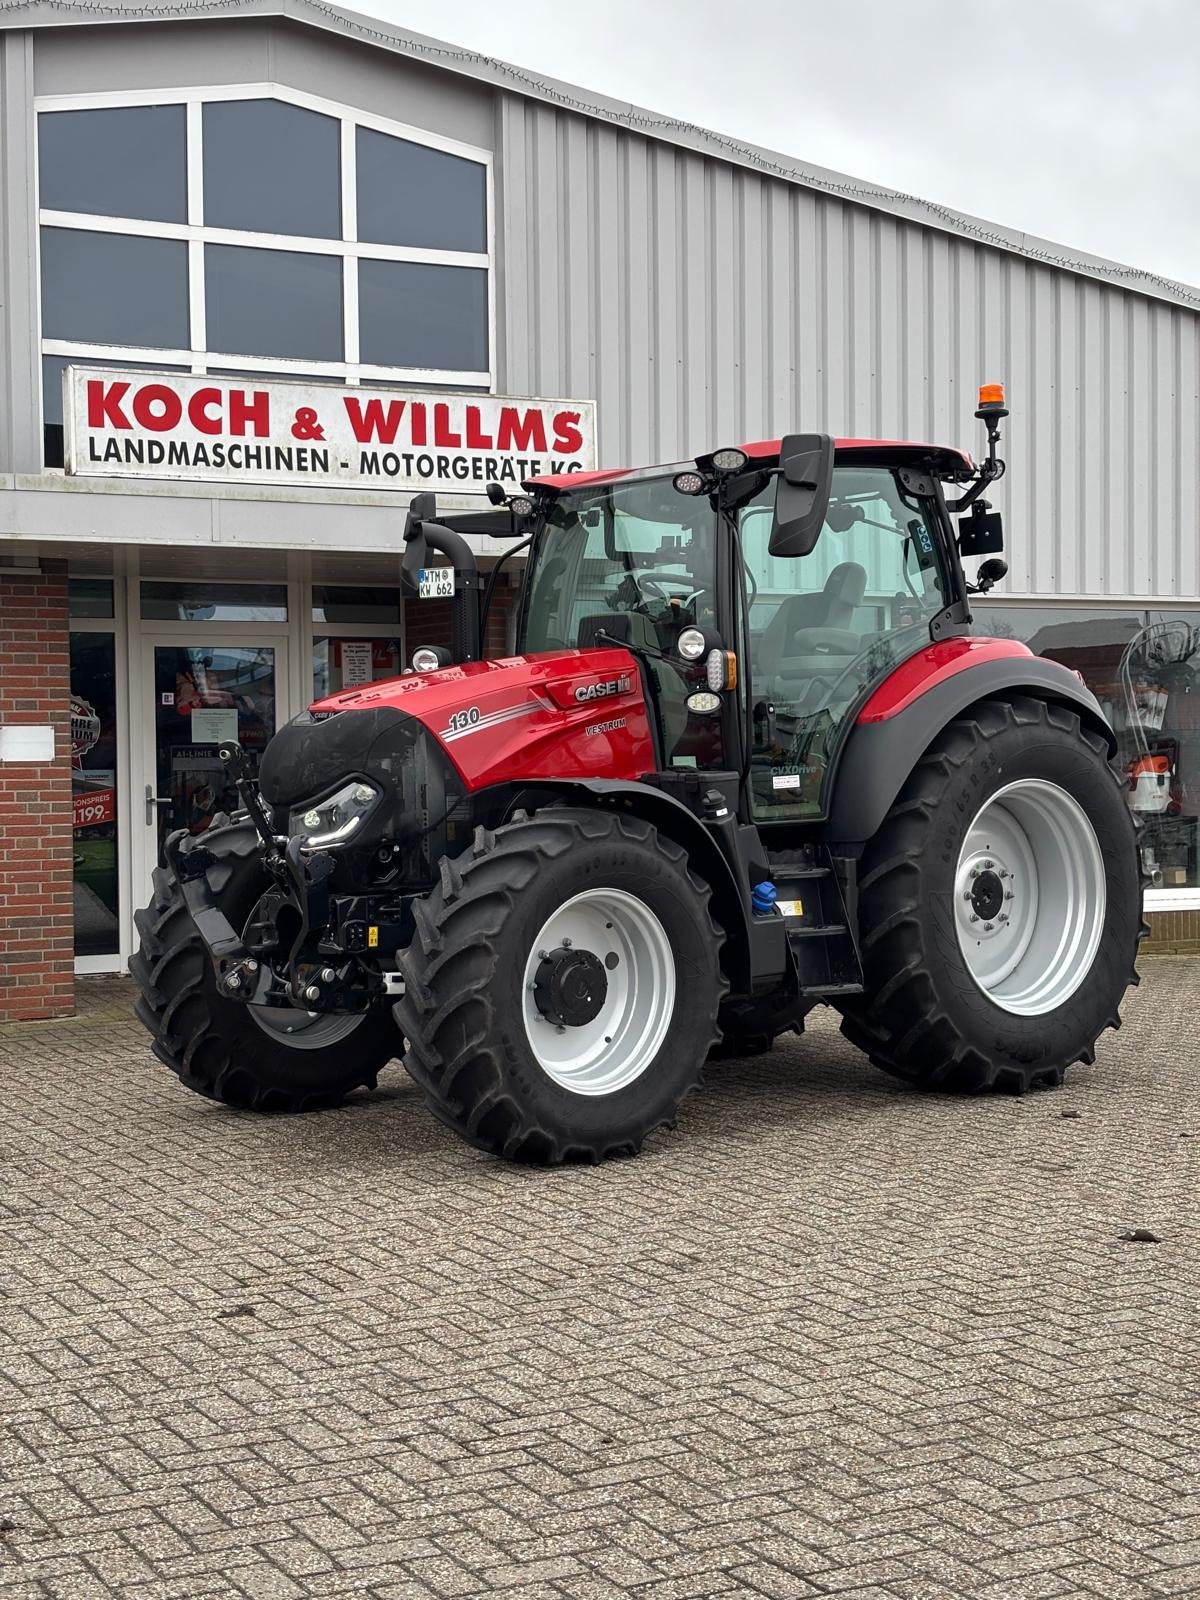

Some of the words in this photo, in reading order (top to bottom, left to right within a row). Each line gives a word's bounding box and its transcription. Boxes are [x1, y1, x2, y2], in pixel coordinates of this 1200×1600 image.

[87, 380, 270, 437] KOCH
[291, 407, 327, 441] &
[343, 397, 583, 454] WILLMS
[89, 436, 329, 473] LANDMASCHINEN
[360, 451, 541, 481] MOTORGERÄTE
[420, 584, 431, 597] KW
[436, 582, 453, 595] 662
[575, 681, 616, 701] CASE
[449, 706, 480, 731] 130
[585, 717, 627, 737] VESTRUM
[770, 764, 817, 776] CVXDrive
[73, 794, 110, 807] IONSPREIS
